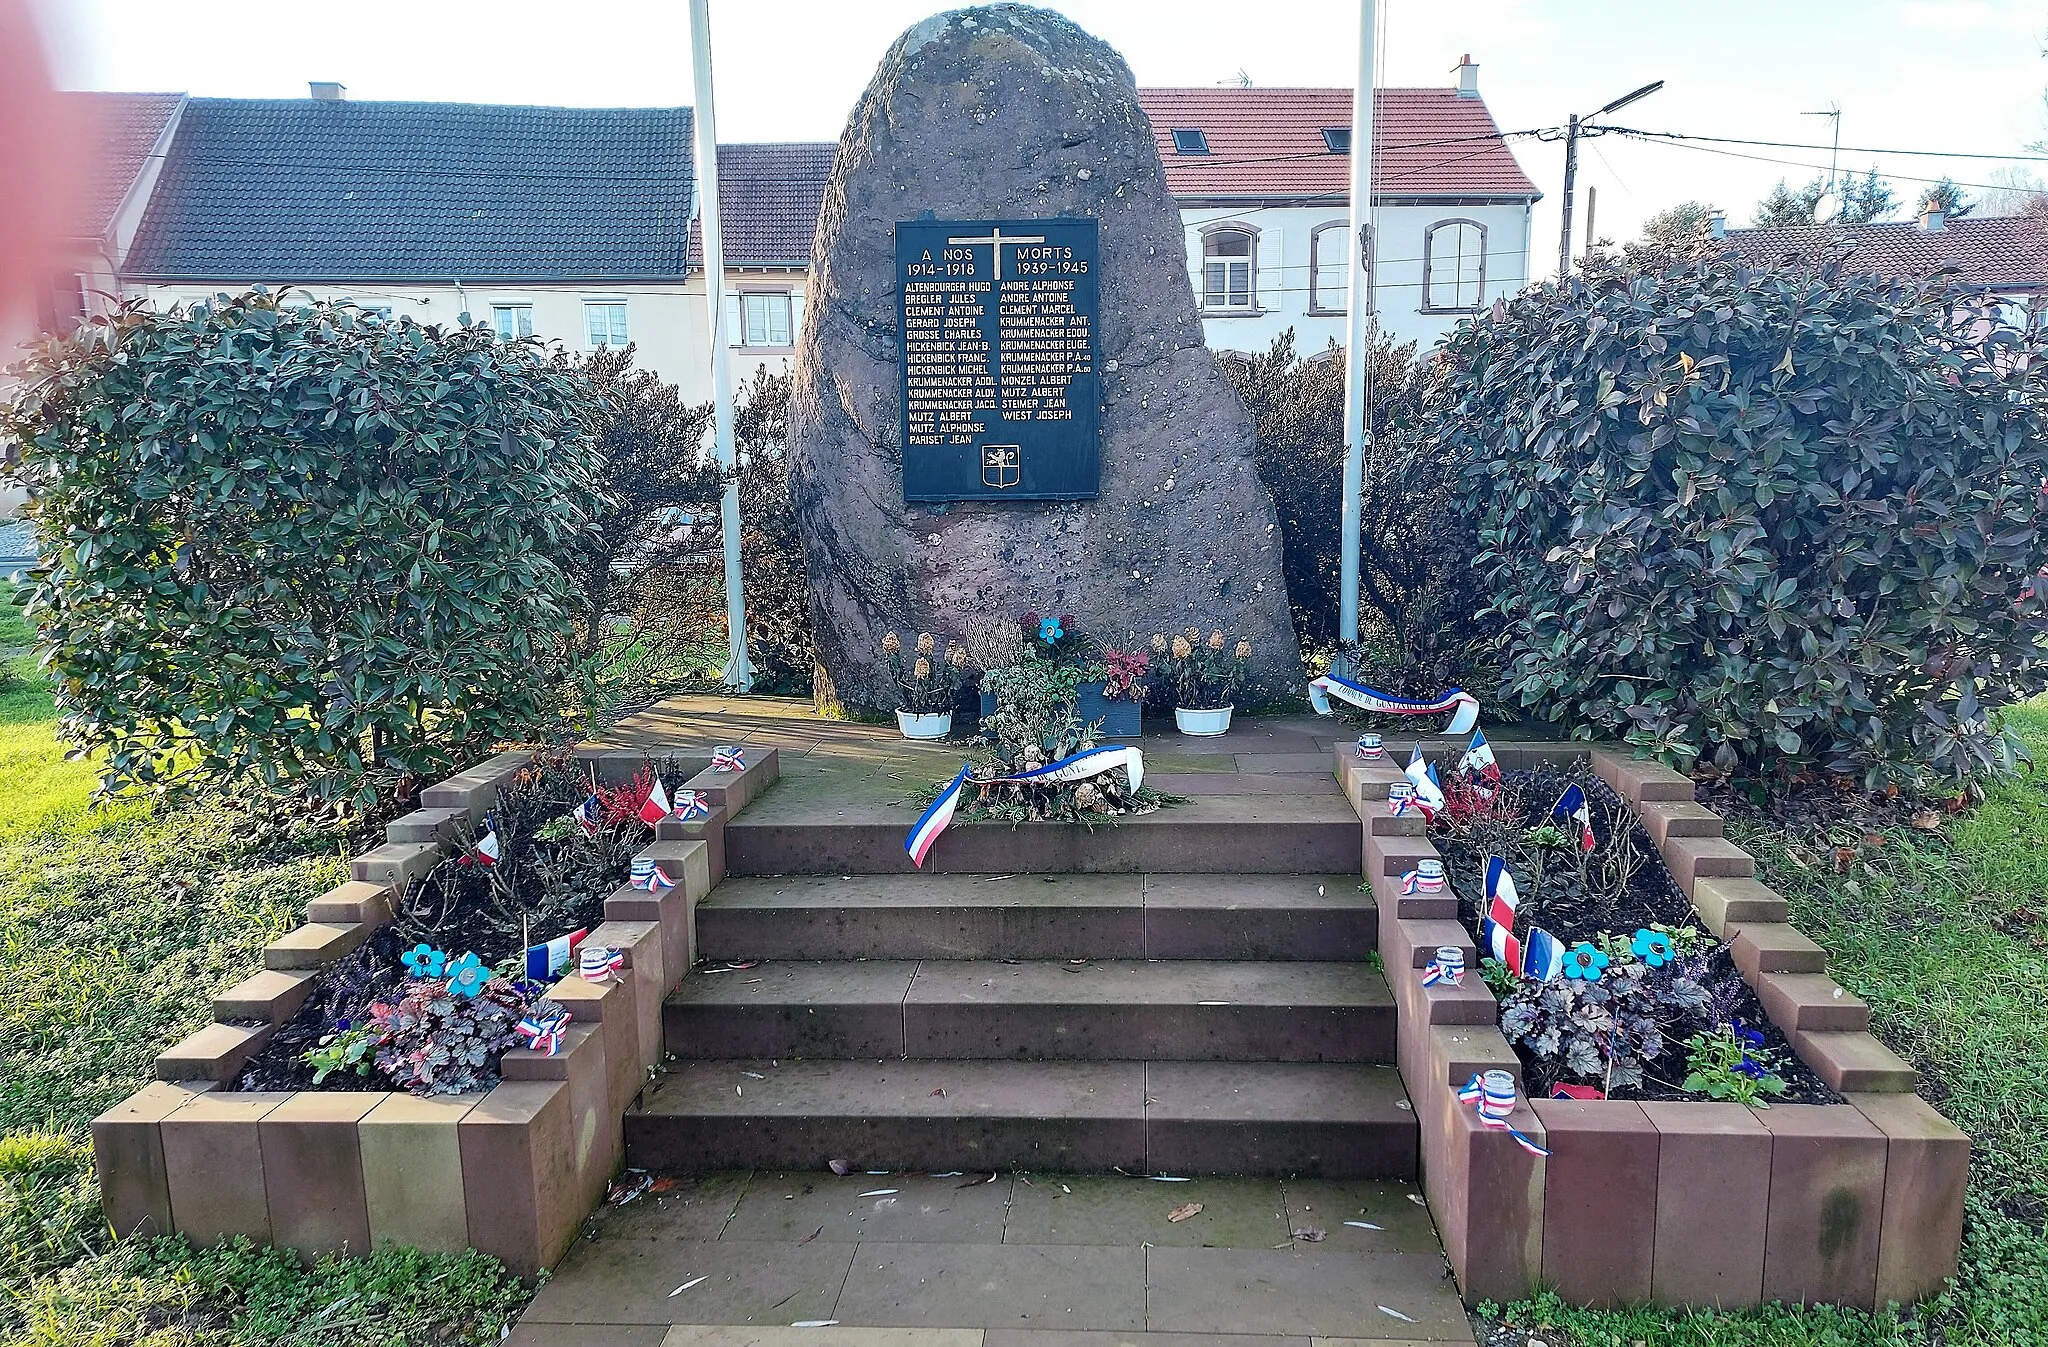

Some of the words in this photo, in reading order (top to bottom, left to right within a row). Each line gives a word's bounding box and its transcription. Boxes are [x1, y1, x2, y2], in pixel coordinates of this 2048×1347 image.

[922, 250, 931, 261] A
[943, 249, 973, 260] NOS
[1017, 247, 1072, 259] MORTS
[907, 263, 975, 276] 1914-1918
[1017, 261, 1088, 274] 1939-1945
[905, 282, 966, 293] ALTENBOURGER
[969, 282, 991, 292] HUGO
[1000, 281, 1029, 291] ANDRE
[1032, 281, 1074, 290] ALPHONSE
[906, 295, 942, 304] BREGLER
[949, 294, 975, 304] JULES
[1000, 293, 1029, 303] ANDRE
[1032, 293, 1068, 302] ANTOINE
[906, 307, 945, 316] CLEMENT
[949, 306, 984, 315] ANTOINE
[1000, 305, 1037, 315] CLEMENT
[1041, 305, 1075, 314] MARCEL
[906, 318, 939, 328] GERARD
[944, 318, 975, 327] JOSEPH
[1000, 317, 1064, 326] KRUMMENACKER
[1070, 317, 1090, 326] ANT.
[907, 330, 939, 340] GROSSE
[945, 330, 981, 339] CHARLES
[1000, 329, 1064, 338] KRUMMENACKER
[1067, 328, 1090, 337] EDOU.
[907, 342, 955, 352] HICKENBICK
[958, 342, 990, 351] JEAN-B.
[1000, 341, 1064, 350] KRUMMENACKER
[1067, 340, 1090, 349] EUGE.
[907, 354, 955, 363] HICKENBICK
[958, 354, 990, 363] FRANC.
[1000, 352, 1064, 362] KRUMMENACKER
[908, 366, 956, 375] HICKENBICK
[959, 365, 988, 374] MICHEL
[1001, 364, 1065, 374] KRUMMENACKER
[908, 377, 972, 387] KRUMMENACKER
[975, 377, 997, 386] ADOL.
[1001, 376, 1036, 385] MONZEL
[1040, 376, 1072, 384] ALBERT
[908, 389, 972, 398] KRUMMENACKER
[975, 388, 996, 398] ALOY.
[1002, 388, 1027, 397] MUTZ
[1031, 388, 1064, 397] ALBERT
[909, 400, 973, 410] KRUMMENACKER
[975, 400, 998, 409] JACQ.
[1002, 400, 1038, 409] STEIMER
[1044, 399, 1066, 408] JEAN
[909, 412, 934, 422] MUTZ
[940, 412, 972, 421] ALBERT
[1002, 411, 1032, 420] WIEST
[1036, 411, 1071, 420] JOSEPH
[909, 424, 935, 433] MUTZ
[940, 423, 985, 432] ALPHONSE
[910, 435, 944, 445] PARISET
[949, 435, 972, 444] JEAN
